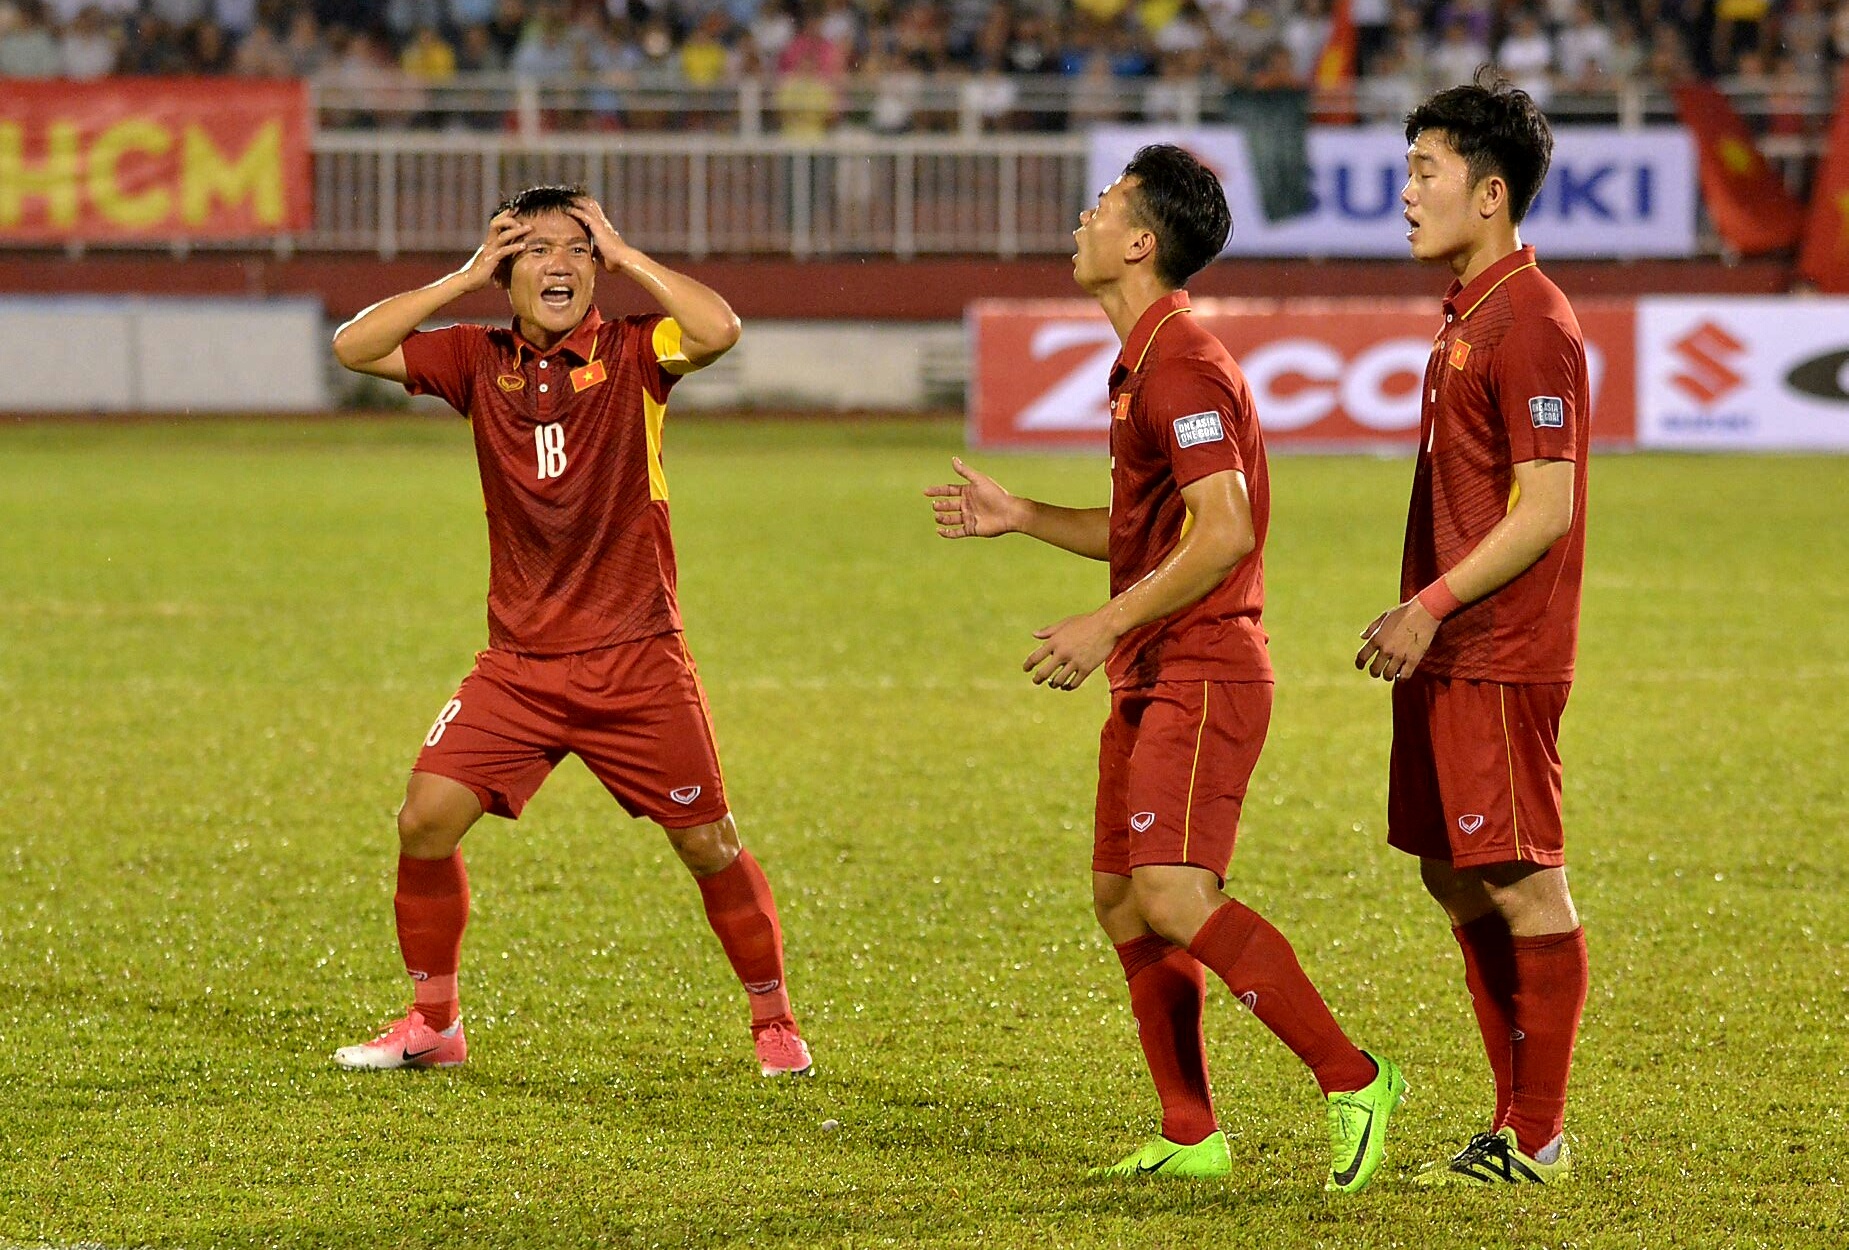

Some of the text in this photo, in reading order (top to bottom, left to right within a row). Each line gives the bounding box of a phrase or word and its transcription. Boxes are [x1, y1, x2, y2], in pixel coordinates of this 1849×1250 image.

[0, 117, 283, 227] HCM
[1178, 417, 1216, 433] ONE ASIA
[1180, 426, 1219, 443] ONE GOAL
[535, 422, 567, 479] 18
